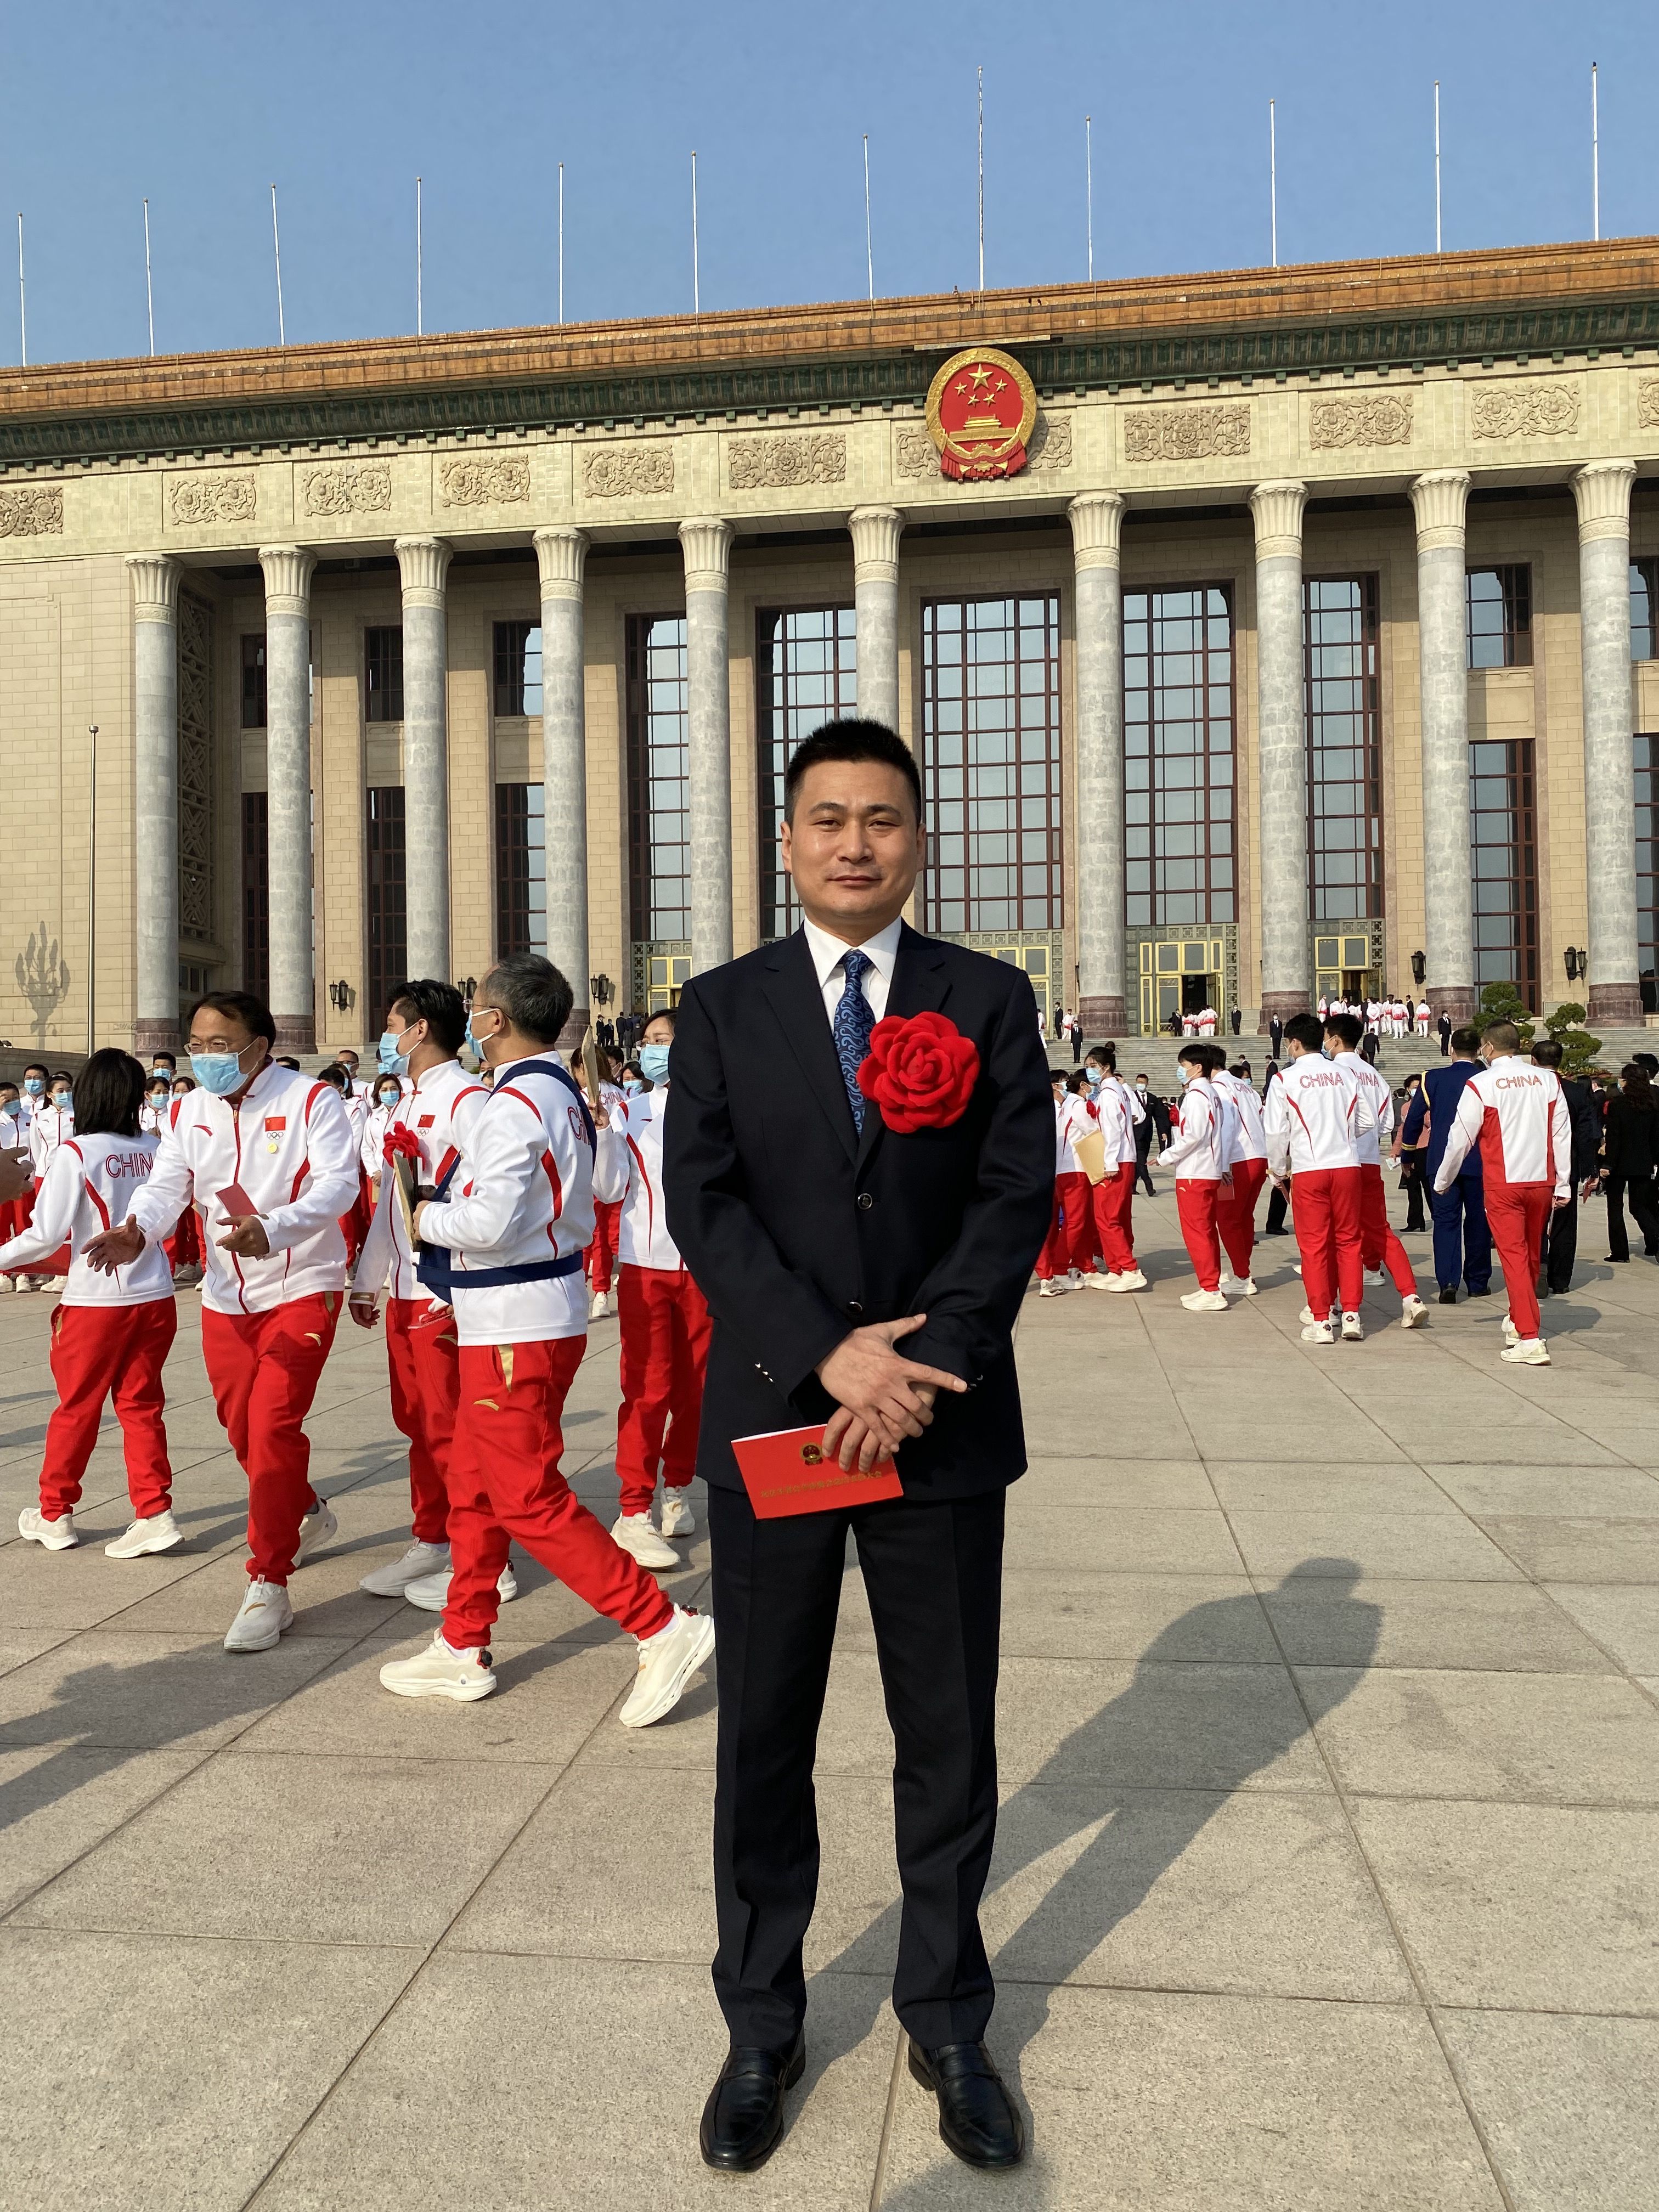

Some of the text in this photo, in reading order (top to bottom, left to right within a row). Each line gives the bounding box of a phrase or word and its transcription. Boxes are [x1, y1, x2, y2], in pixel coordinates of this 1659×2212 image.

[1300, 1072, 1344, 1088] CHINA
[1355, 1071, 1380, 1088] HINA
[1496, 1075, 1542, 1090] CHINA
[106, 1153, 153, 1178] CHIN
